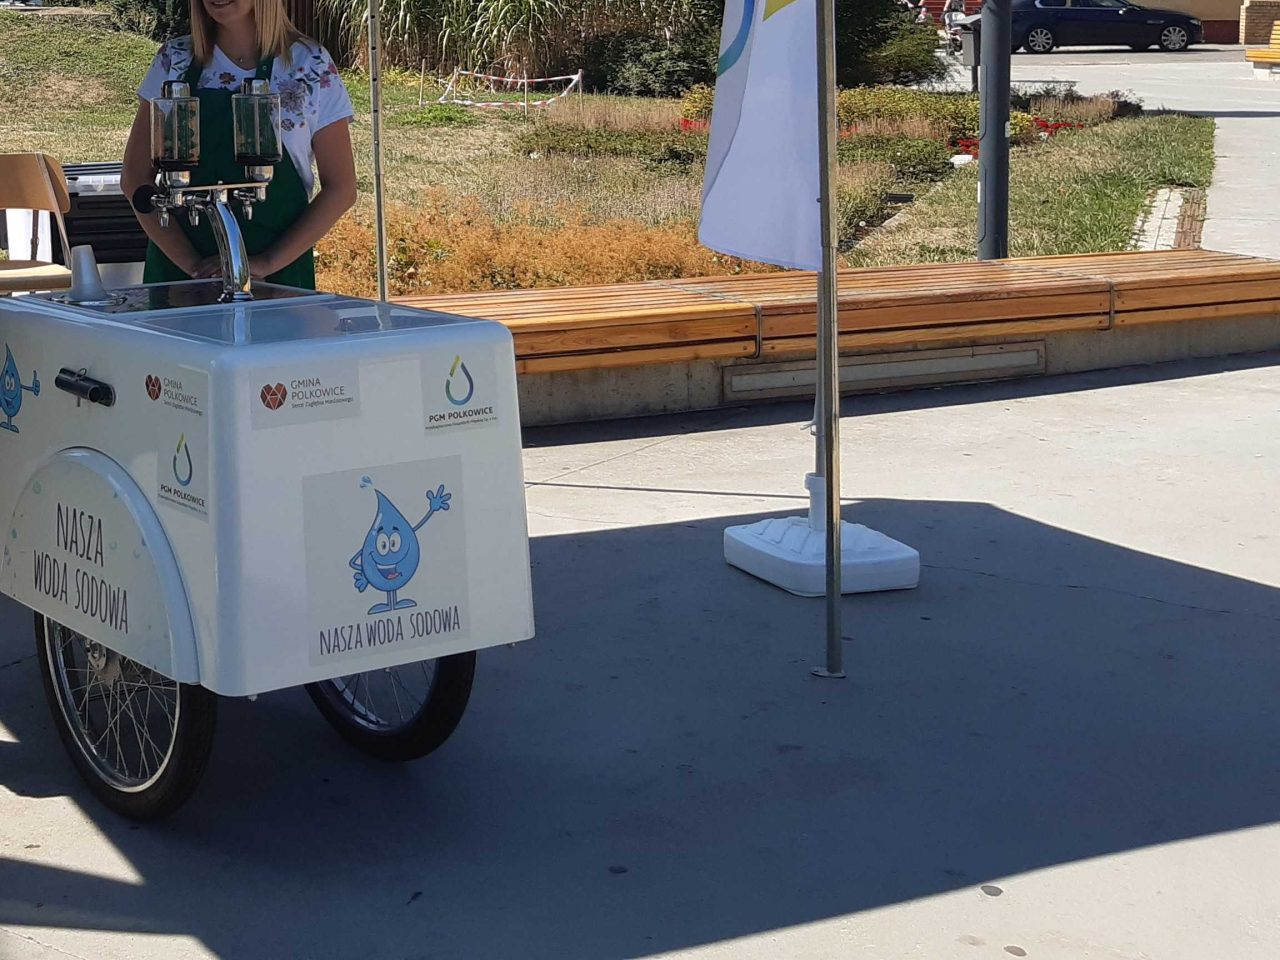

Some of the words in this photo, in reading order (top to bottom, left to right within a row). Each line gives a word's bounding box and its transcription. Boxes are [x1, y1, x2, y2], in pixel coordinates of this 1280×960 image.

[163, 377, 183, 391] GMINA
[290, 377, 321, 389] GMINA
[291, 385, 345, 400] POLKOWICE
[163, 388, 198, 407] POLKOWICE
[429, 413, 446, 423] PGM
[448, 406, 494, 420] POLKOWICE
[160, 483, 172, 495] PGM
[173, 488, 206, 508] POLKOWICE
[56, 502, 104, 568] NASZA
[33, 549, 68, 605] WODA
[74, 568, 129, 635] SODOWA
[320, 623, 363, 656] NASZA
[366, 615, 404, 647] WODA
[409, 605, 461, 639] SODOWA
